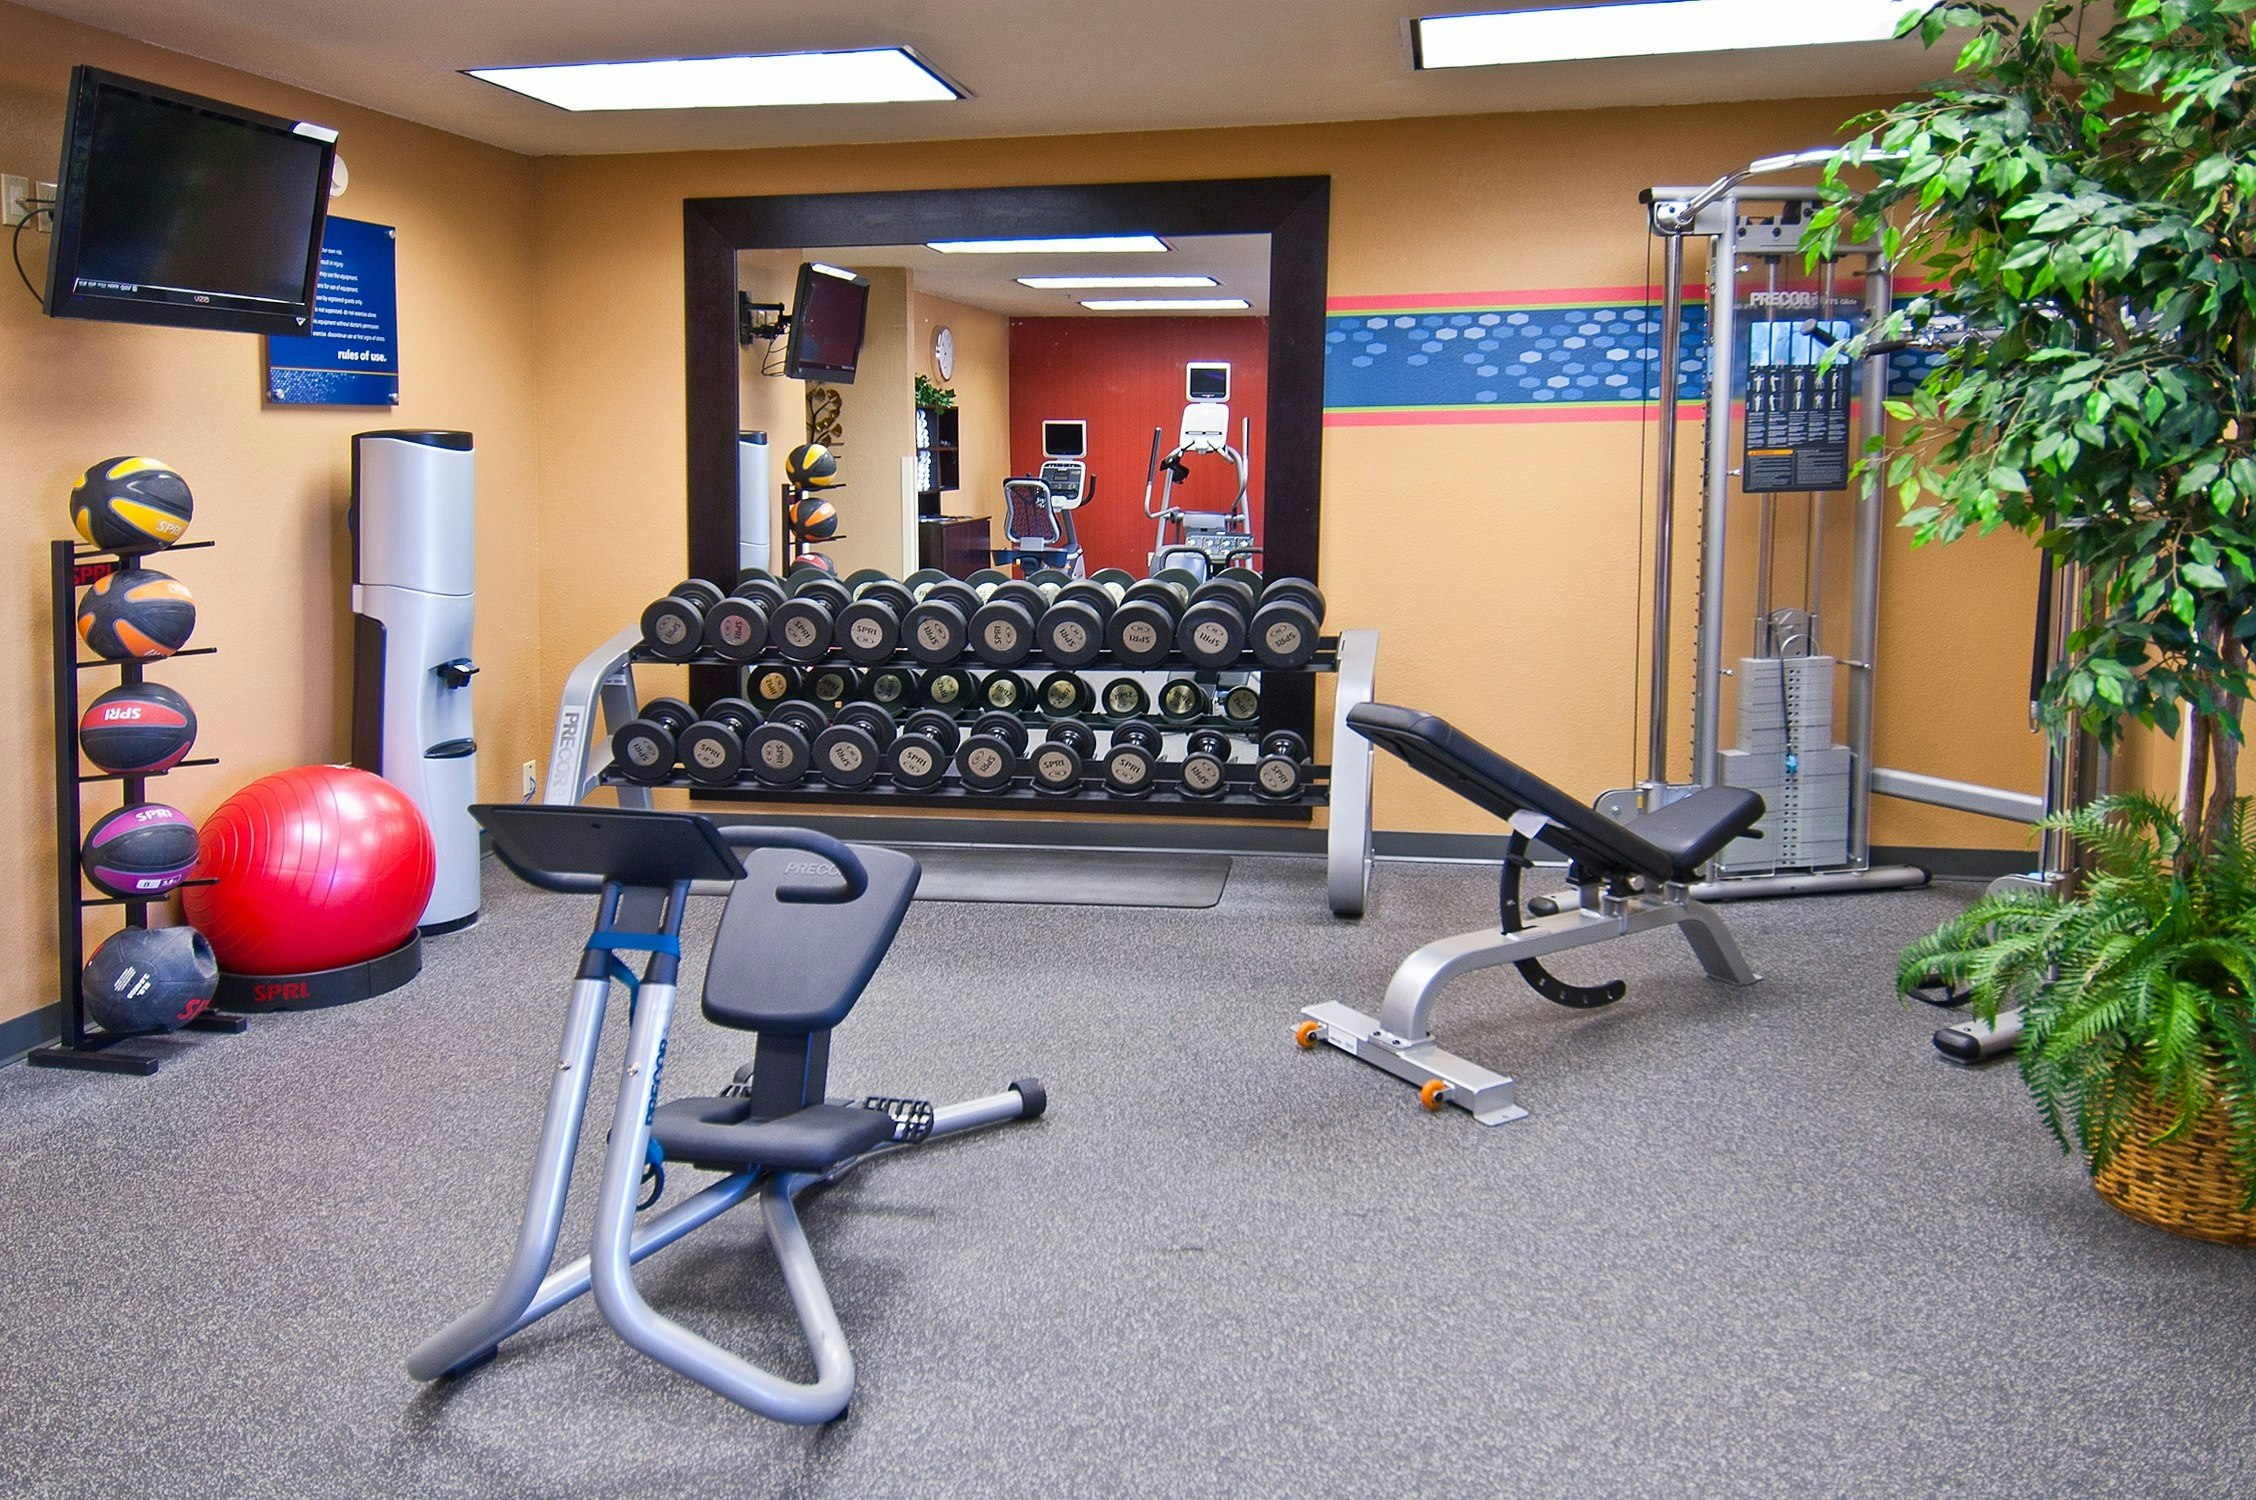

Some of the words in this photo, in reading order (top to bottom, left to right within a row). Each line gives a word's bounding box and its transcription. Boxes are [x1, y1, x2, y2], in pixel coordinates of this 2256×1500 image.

[1750, 291, 1811, 306] PRECOR
[338, 349, 359, 360] rules
[360, 350, 370, 361] of
[370, 353, 387, 362] use.
[156, 521, 183, 536] SPRI
[734, 620, 743, 639] SPRI
[794, 620, 811, 639] SPRI
[856, 625, 877, 636] SPRI
[924, 625, 940, 645] SPRI
[993, 625, 1002, 645] SPRI
[1059, 628, 1076, 648] SPRI
[1128, 634, 1151, 644] SPRI
[1199, 632, 1221, 647] SPRI
[1274, 632, 1296, 647] SPRI
[104, 707, 142, 720] SPRI
[632, 743, 649, 762] SPRI
[700, 743, 720, 759] SPRI
[775, 744, 784, 764] SPRI
[836, 748, 850, 767] SPRI
[906, 751, 928, 767] SPRI
[980, 754, 996, 773] SPRI
[1043, 759, 1065, 769] SPRI
[1119, 759, 1141, 774] SPRI
[1191, 766, 1209, 785] SPRI
[1270, 765, 1289, 784] SPRI
[135, 808, 173, 822] SPRI
[784, 862, 842, 876] PRECO
[255, 982, 308, 1002] SPRI
